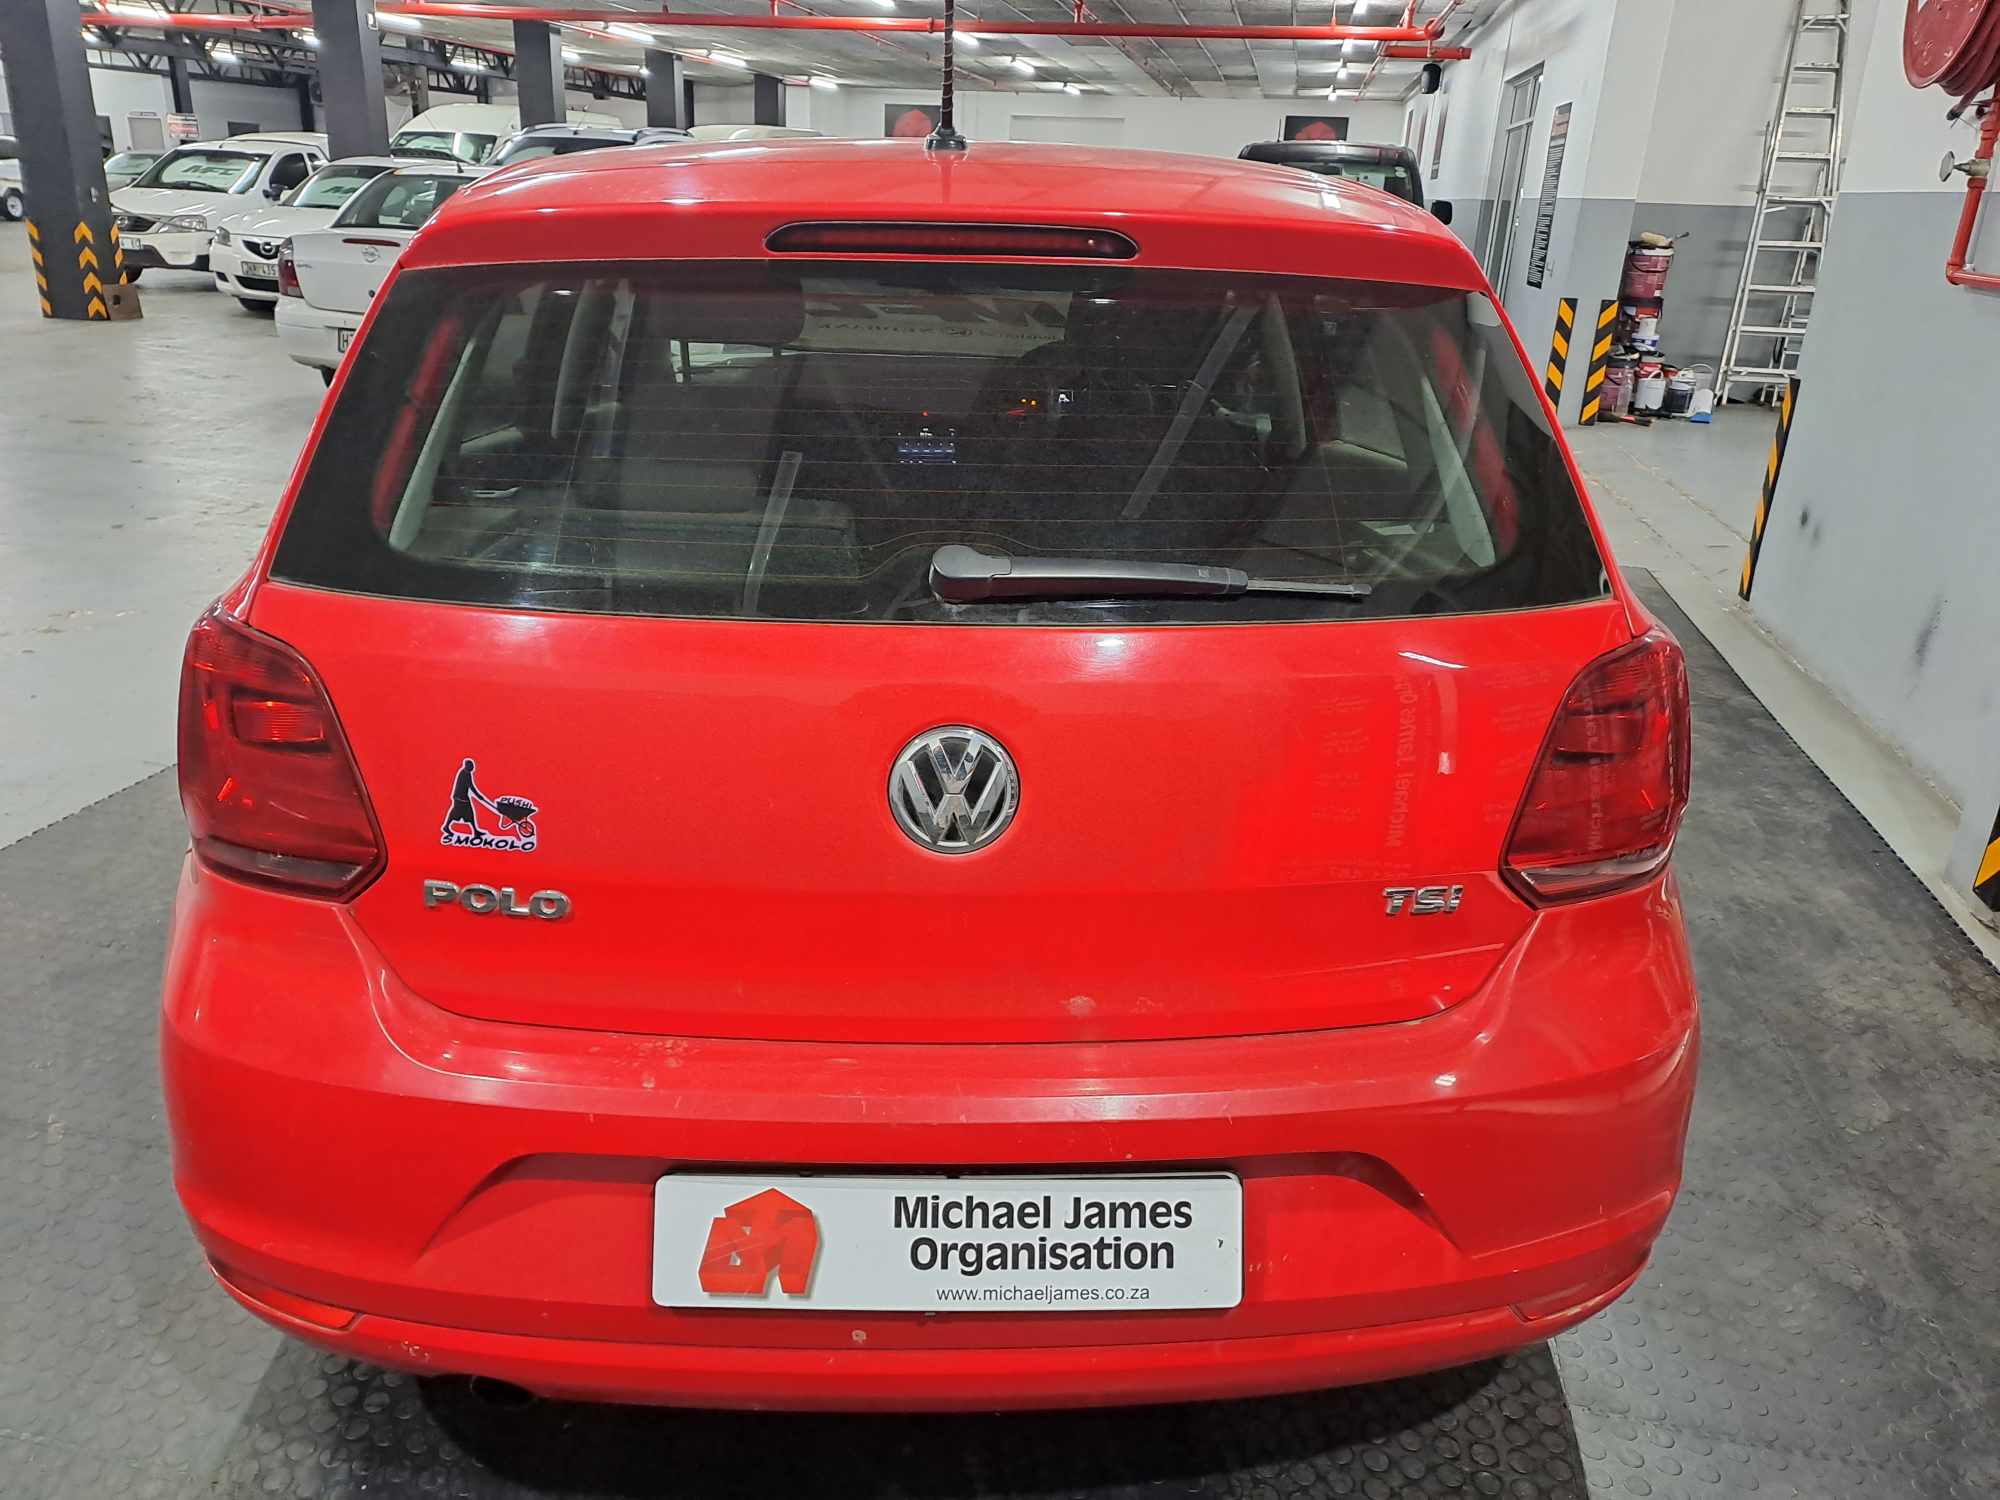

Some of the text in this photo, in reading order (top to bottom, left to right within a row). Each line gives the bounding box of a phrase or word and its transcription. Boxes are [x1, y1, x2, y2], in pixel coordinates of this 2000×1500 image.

[442, 834, 536, 851] SMOKOLO
[424, 879, 571, 919] POLO
[894, 1195, 1192, 1230] Michael James
[910, 1236, 1174, 1276] Organisation
[936, 1284, 1150, 1305] www.michaeljames.co.za
